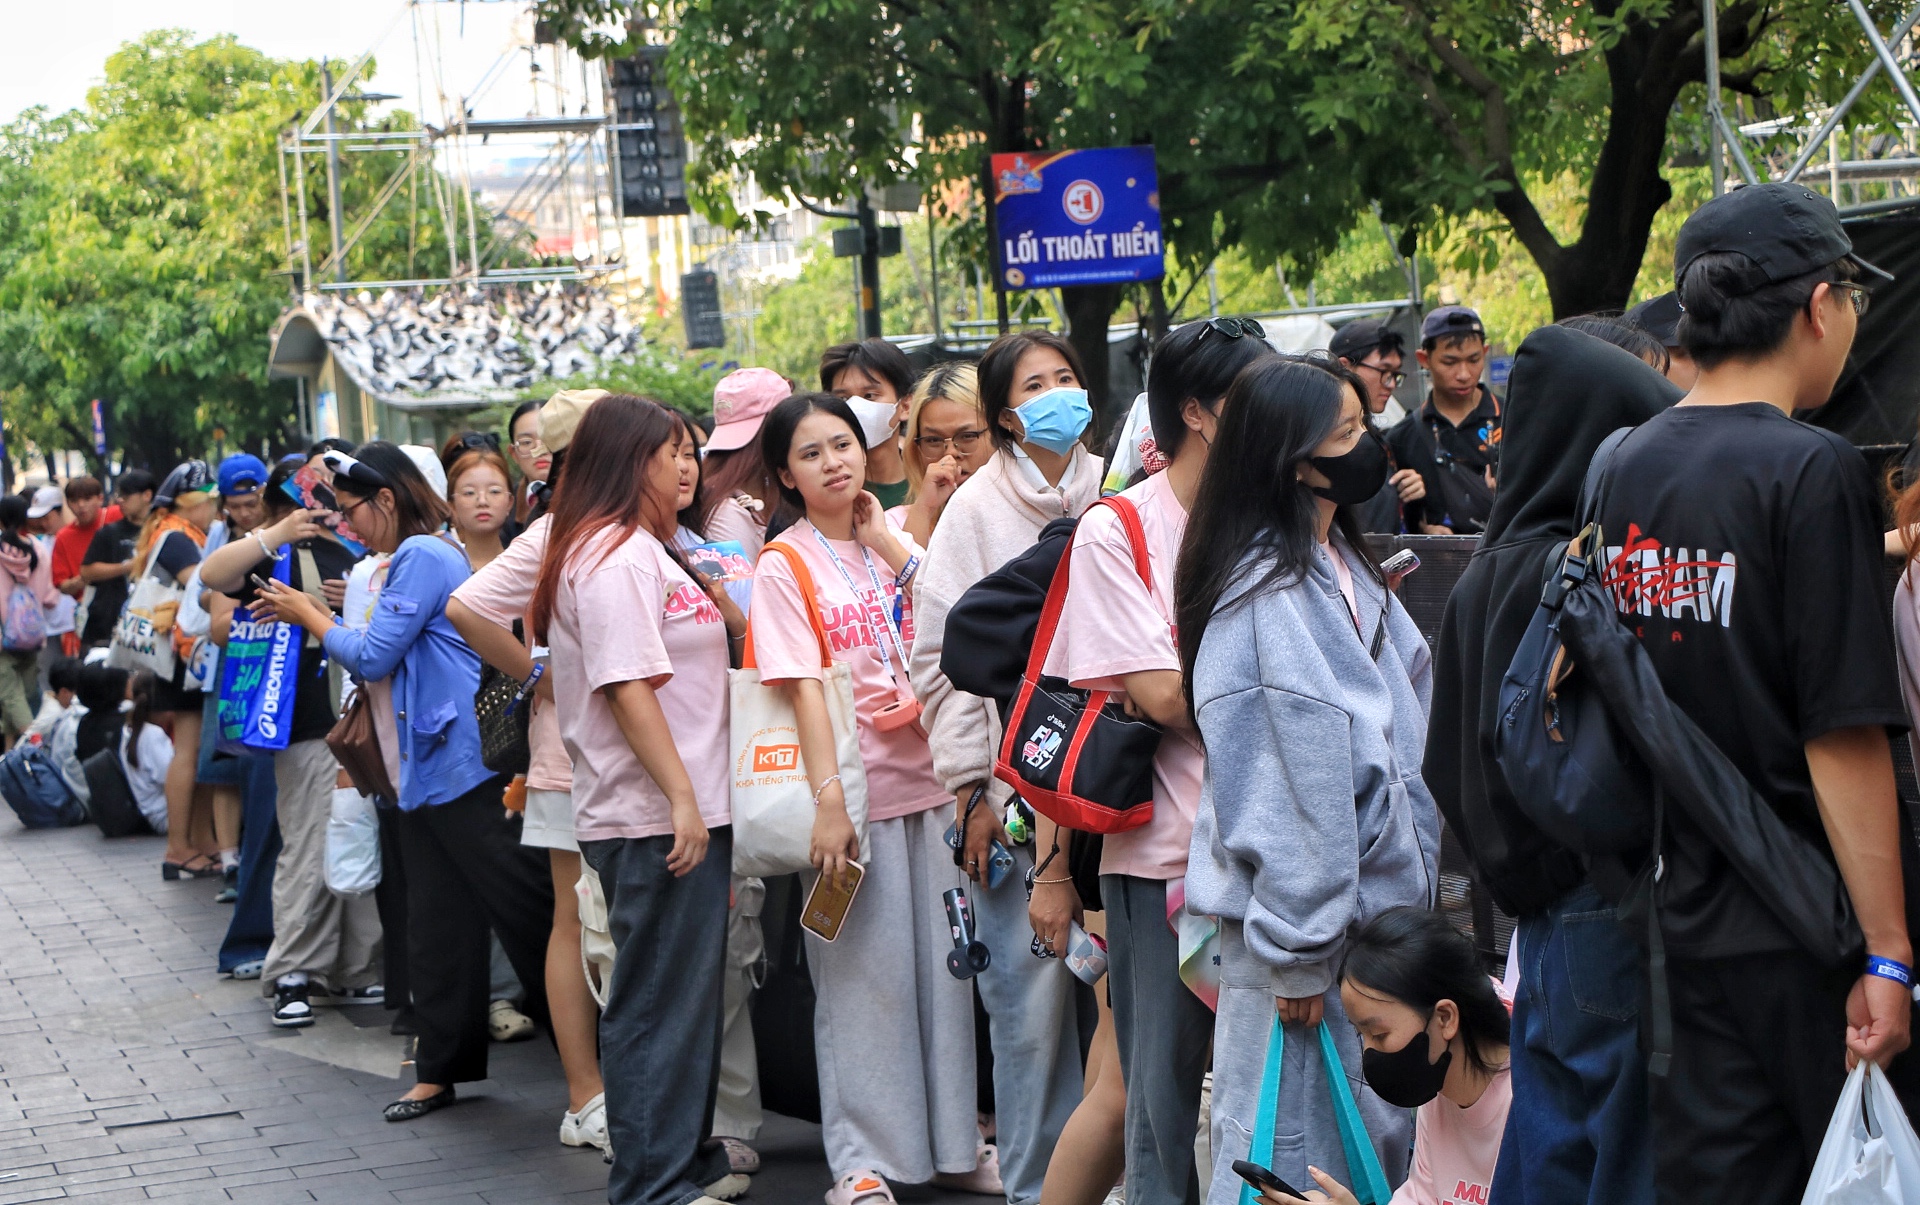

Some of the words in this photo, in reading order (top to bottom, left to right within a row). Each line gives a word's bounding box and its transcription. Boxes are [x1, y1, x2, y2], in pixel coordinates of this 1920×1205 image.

[1005, 230, 1039, 264] LỐI
[1042, 229, 1107, 262] THOÁT
[1111, 221, 1160, 258] HIỂM
[820, 601, 887, 632] UANG
[758, 749, 793, 766] KTT
[735, 779, 755, 789] KHOA
[786, 774, 809, 783] TRUN
